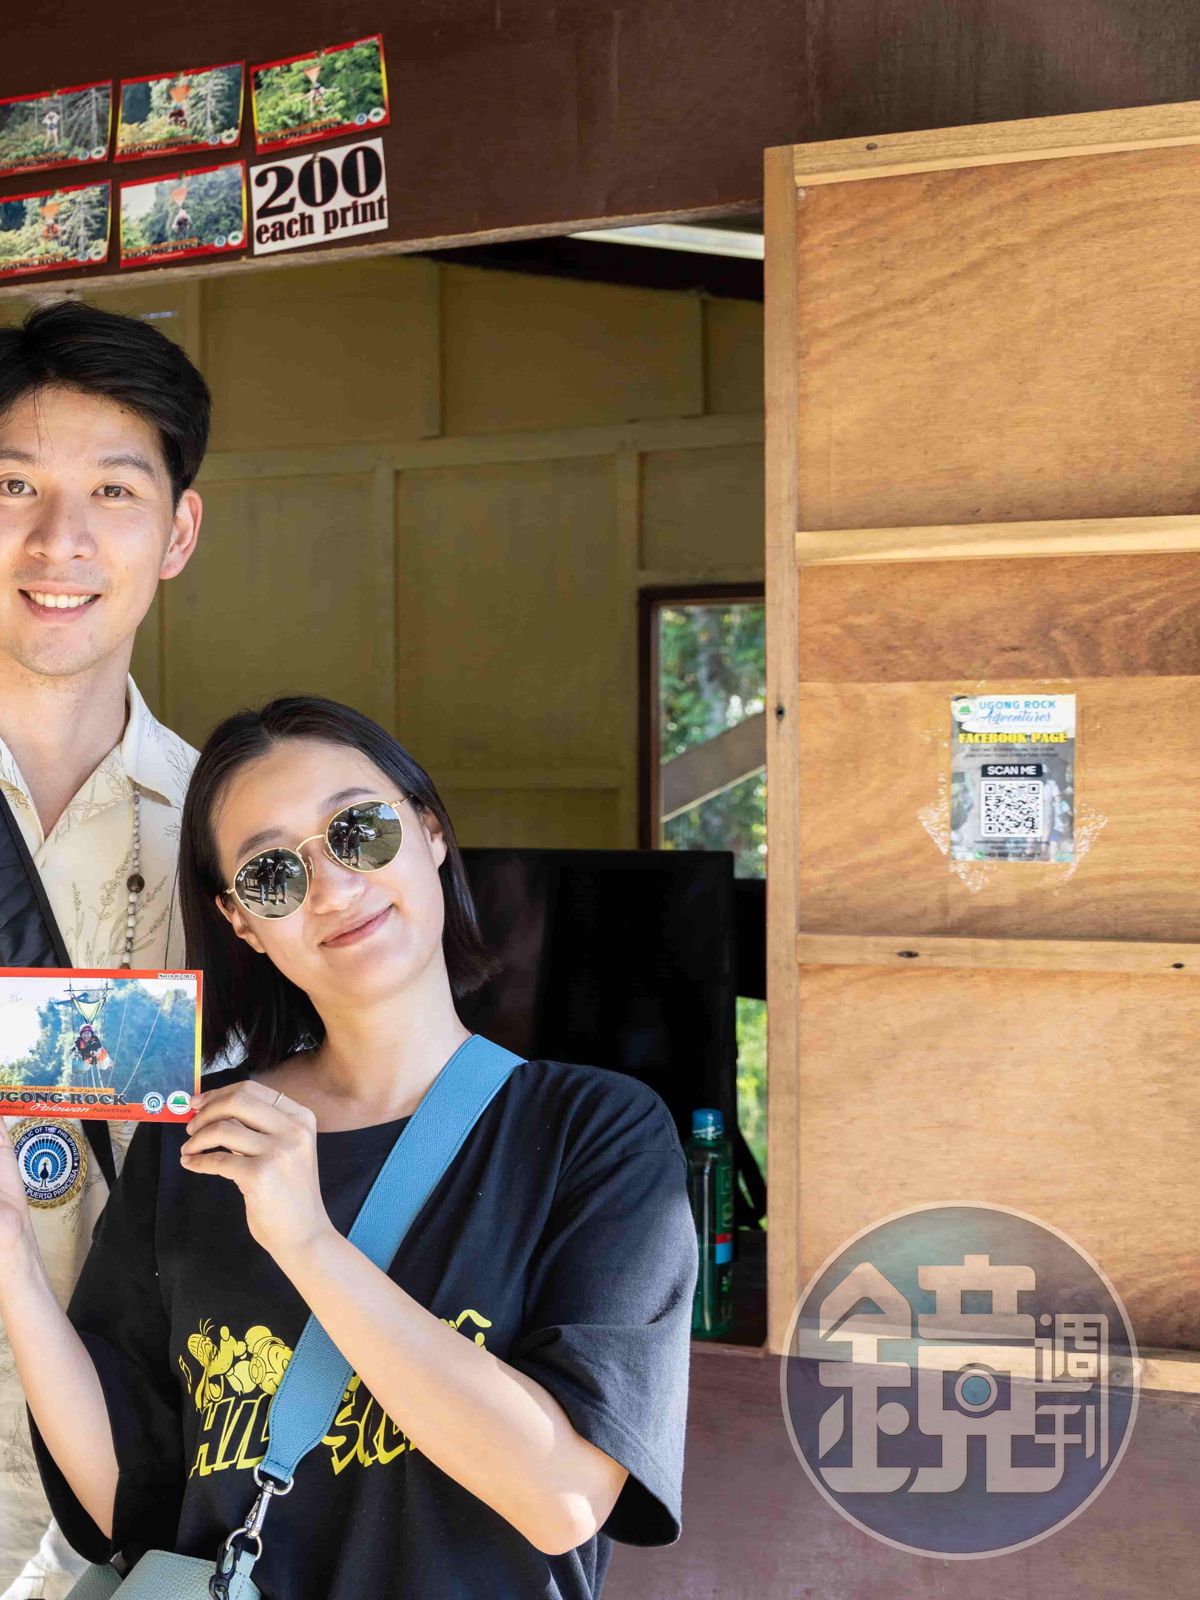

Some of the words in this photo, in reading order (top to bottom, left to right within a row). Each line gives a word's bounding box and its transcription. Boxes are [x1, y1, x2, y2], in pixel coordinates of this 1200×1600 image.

[254, 146, 382, 220] 200
[255, 211, 314, 245] each
[323, 194, 387, 235] print
[979, 701, 1020, 709] UGONG
[1024, 700, 1056, 709] ROCK
[979, 709, 1052, 724] Adventures
[959, 733, 1028, 744] FACEBOOK
[1031, 732, 1067, 744] PAGE
[987, 765, 1019, 775] SCAN
[1020, 765, 1037, 775] ME
[70, 1094, 127, 1105] ROCK
[30, 1102, 90, 1113] Palawan
[15, 1130, 34, 1156] EPUBLIC
[57, 1129, 79, 1160] PHILIPPINES
[26, 1188, 52, 1199] PUERTO
[53, 1169, 78, 1197] PRINCESA
